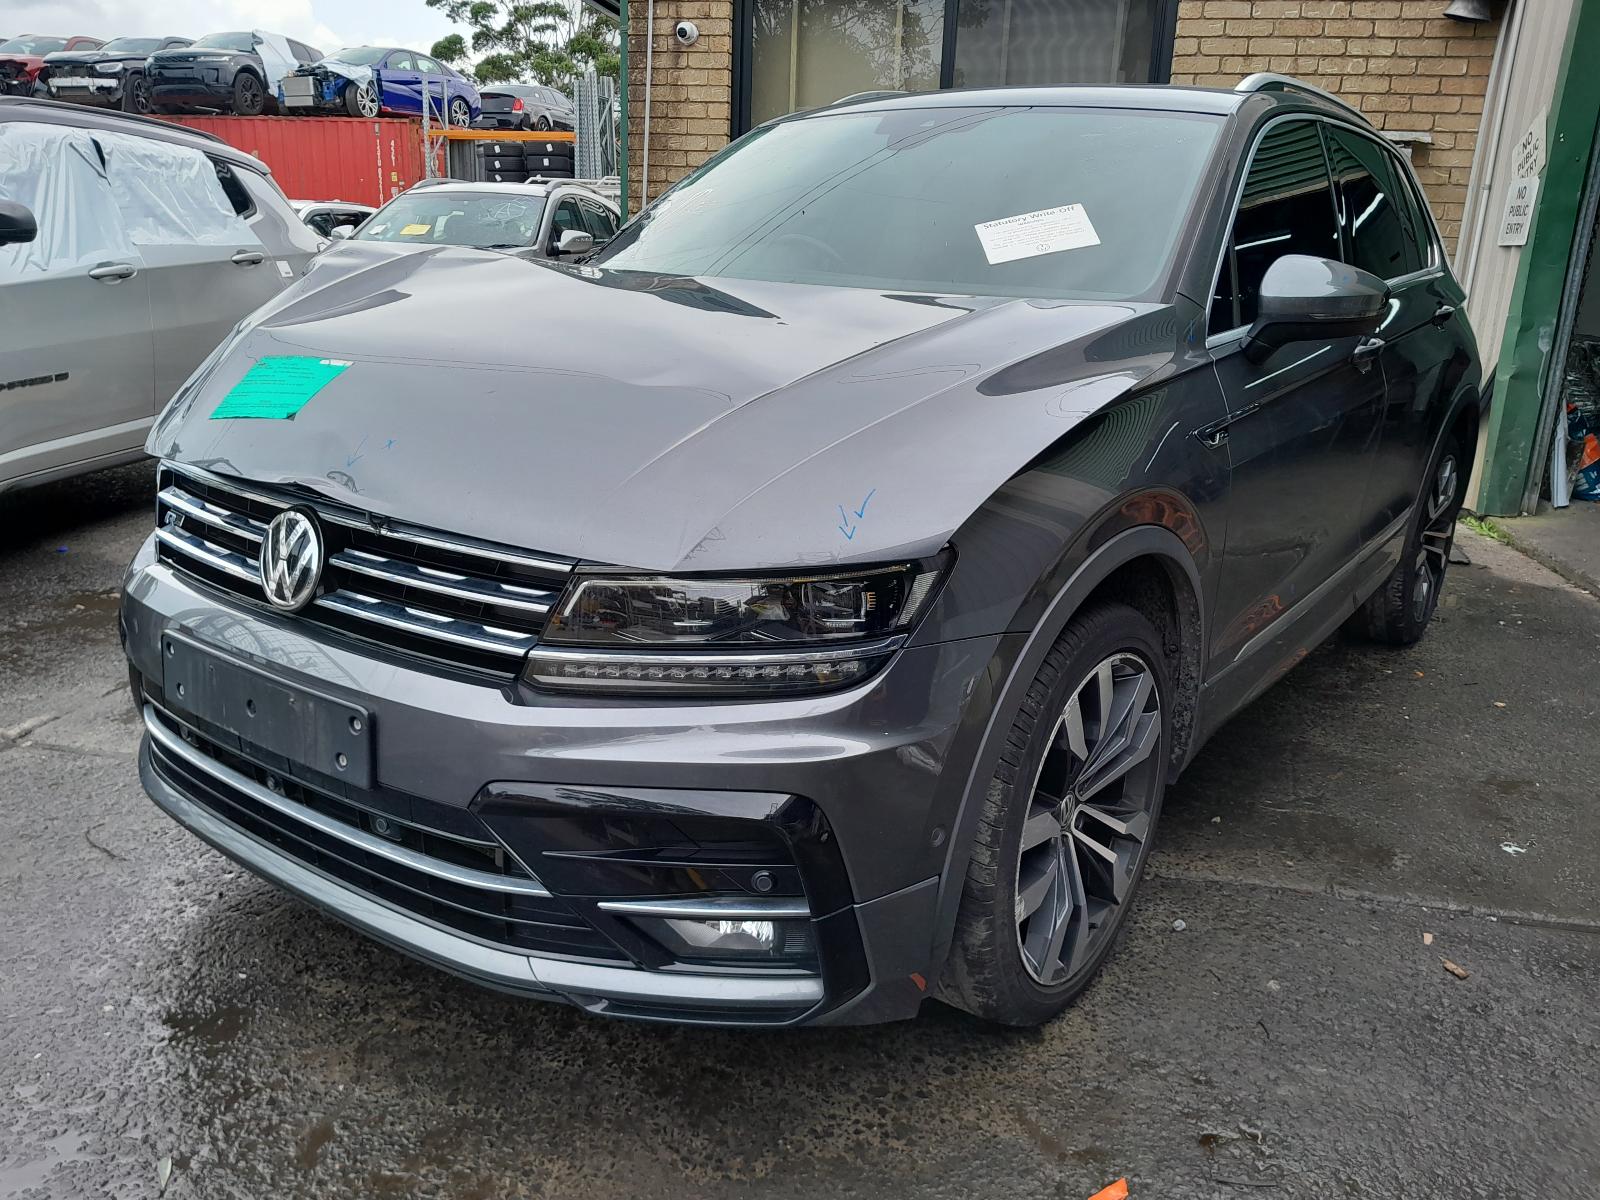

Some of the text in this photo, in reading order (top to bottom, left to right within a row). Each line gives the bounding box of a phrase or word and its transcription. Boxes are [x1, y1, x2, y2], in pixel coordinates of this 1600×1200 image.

[1522, 132, 1532, 153] NO
[1517, 138, 1539, 176] PUBLIC
[1519, 156, 1538, 178] TRY
[1517, 186, 1527, 200] NO
[1509, 205, 1528, 217] PUBLIC
[983, 217, 1027, 230] Statutory
[1506, 223, 1524, 235] ENTRY
[262, 510, 320, 609] VW
